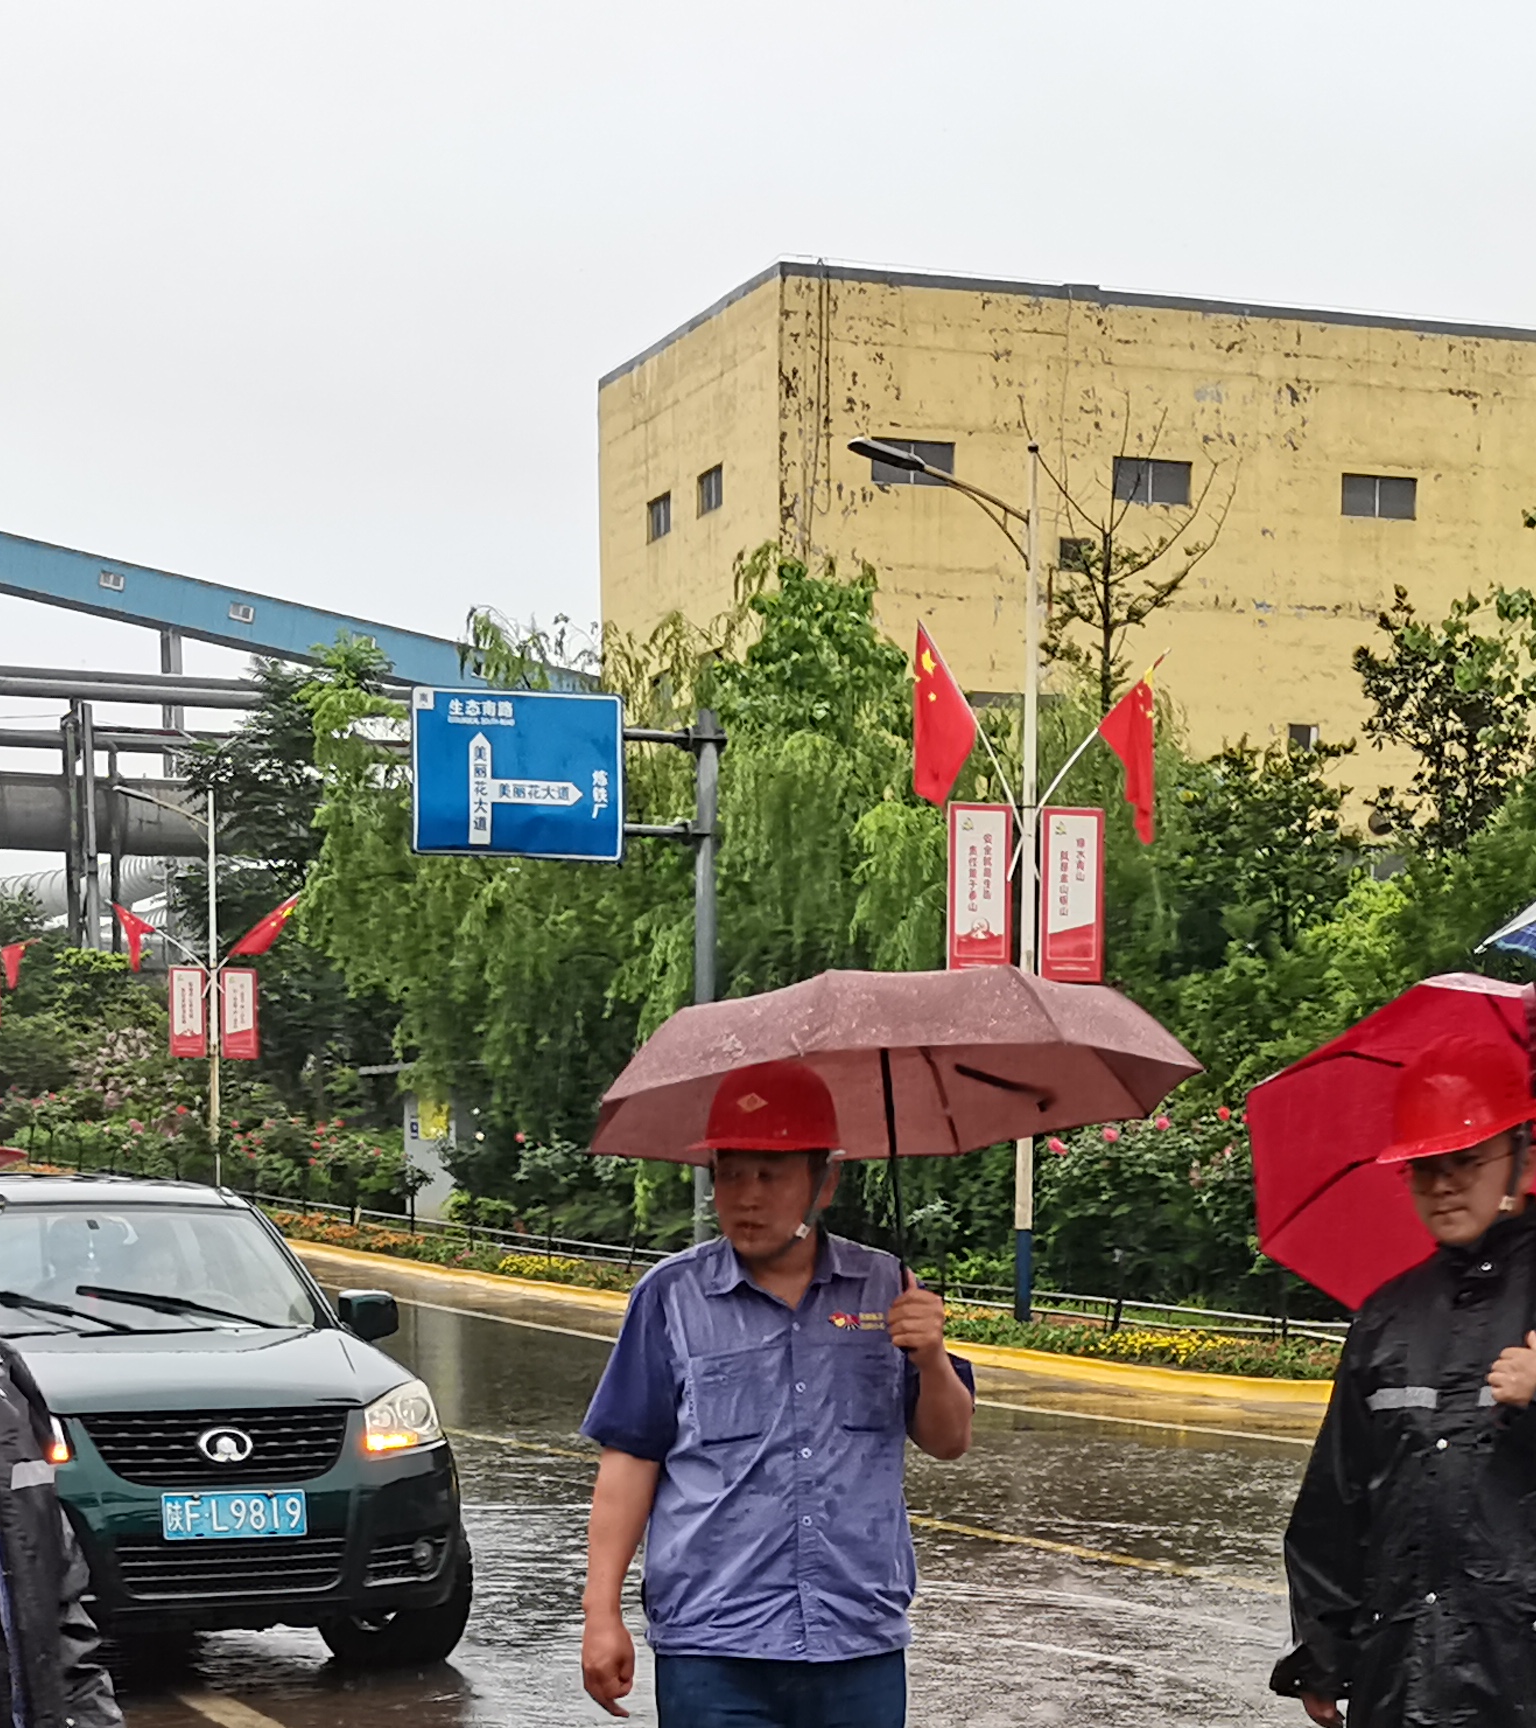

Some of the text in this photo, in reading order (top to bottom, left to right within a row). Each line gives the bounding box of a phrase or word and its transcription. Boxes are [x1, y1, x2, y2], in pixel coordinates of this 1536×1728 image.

[449, 698, 513, 717] 生态南路
[473, 745, 487, 831] 美丽花大道
[498, 784, 570, 801] 美丽花大道
